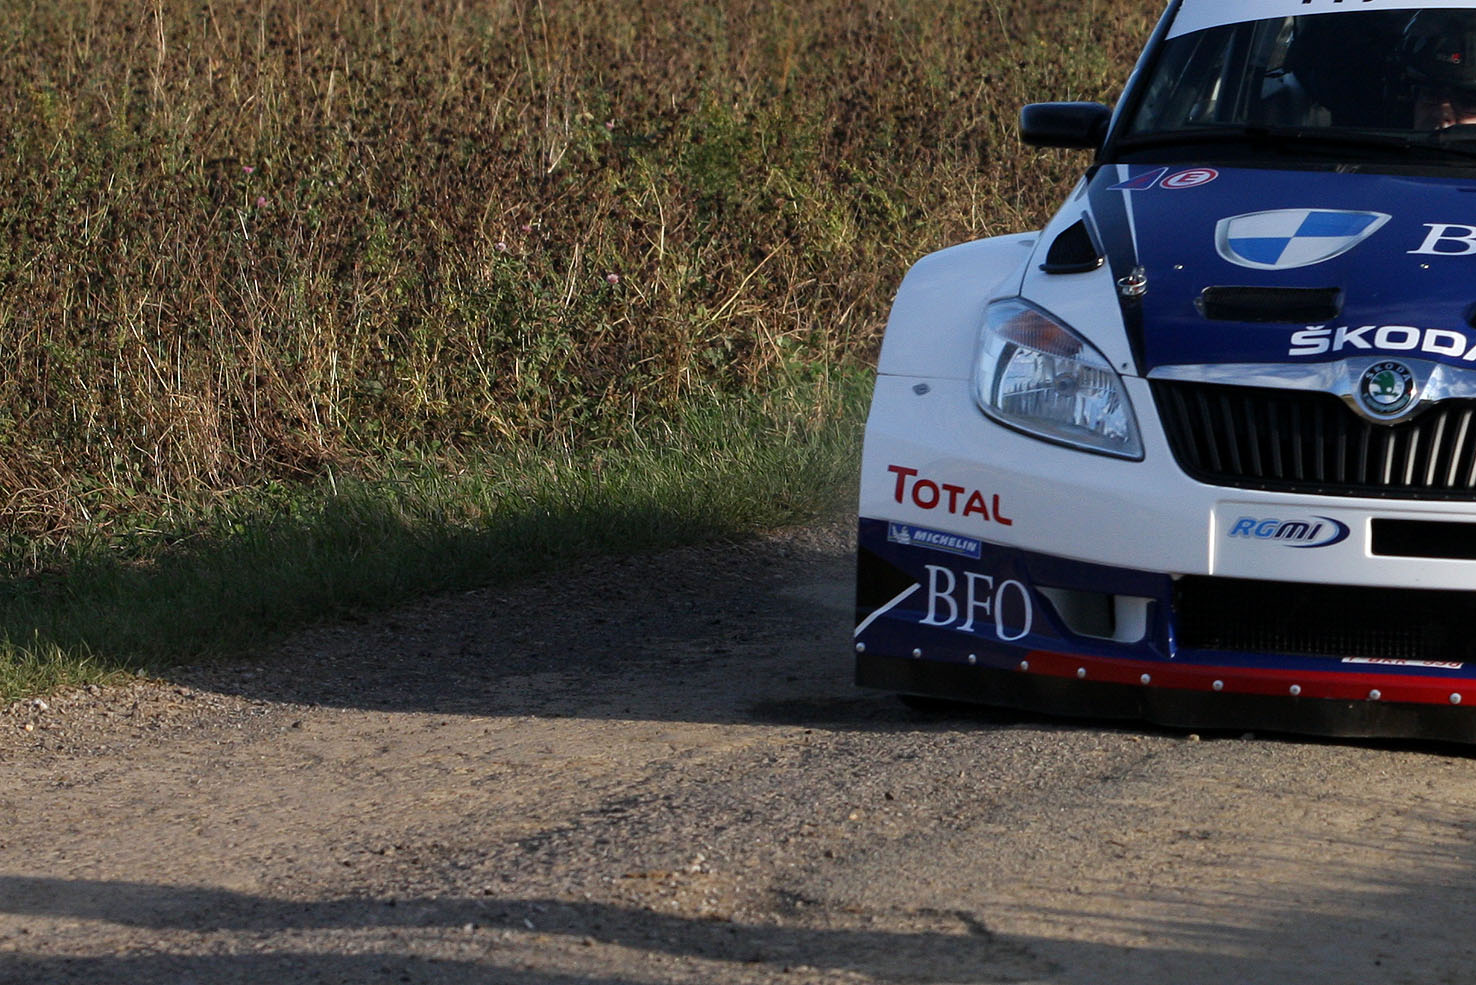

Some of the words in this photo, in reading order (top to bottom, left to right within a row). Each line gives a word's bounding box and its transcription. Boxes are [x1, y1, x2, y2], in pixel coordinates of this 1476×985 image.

[888, 465, 1013, 526] TOTAL
[913, 530, 978, 553] MICHELIN
[919, 564, 1034, 641] BFO
